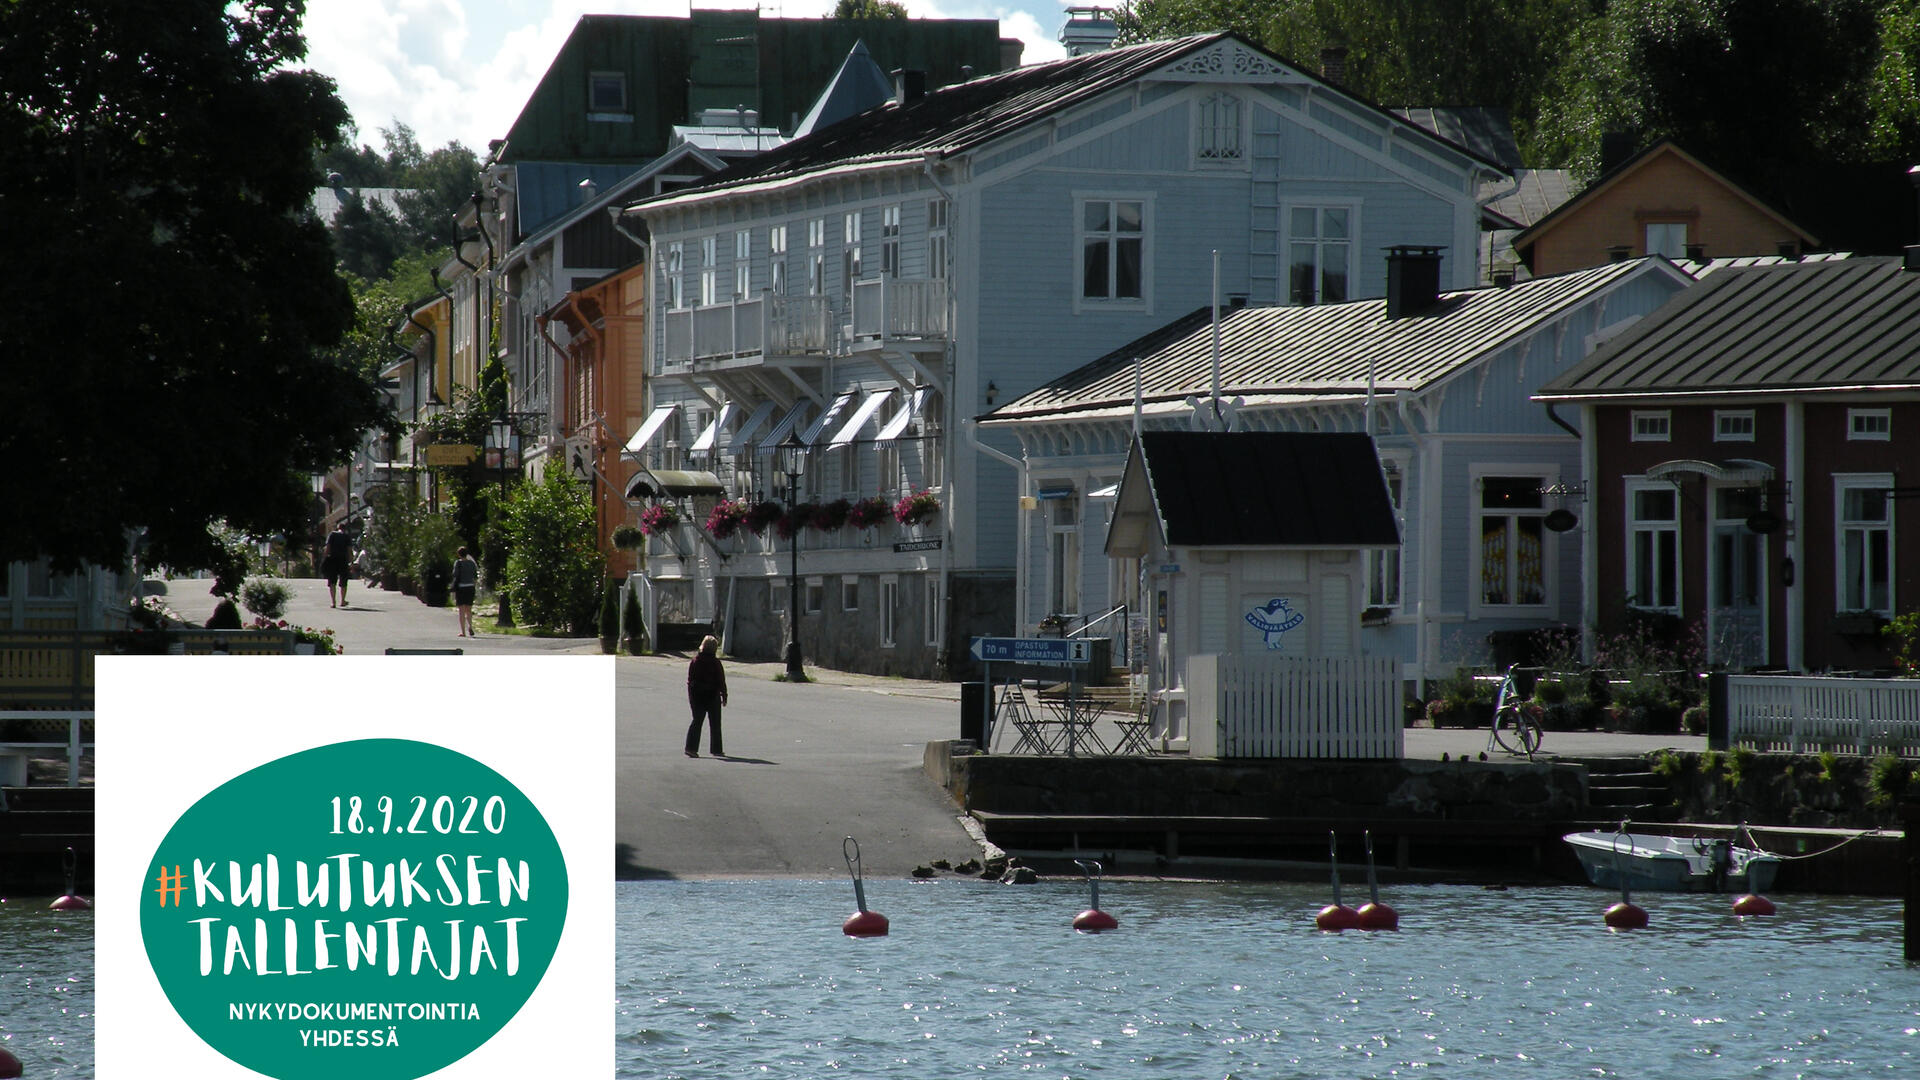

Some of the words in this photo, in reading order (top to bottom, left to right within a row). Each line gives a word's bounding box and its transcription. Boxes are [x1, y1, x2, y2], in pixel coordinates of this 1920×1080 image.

[986, 645, 997, 654] 70
[1015, 641, 1049, 650] OPASTUS
[1015, 650, 1064, 659] INFORMATION
